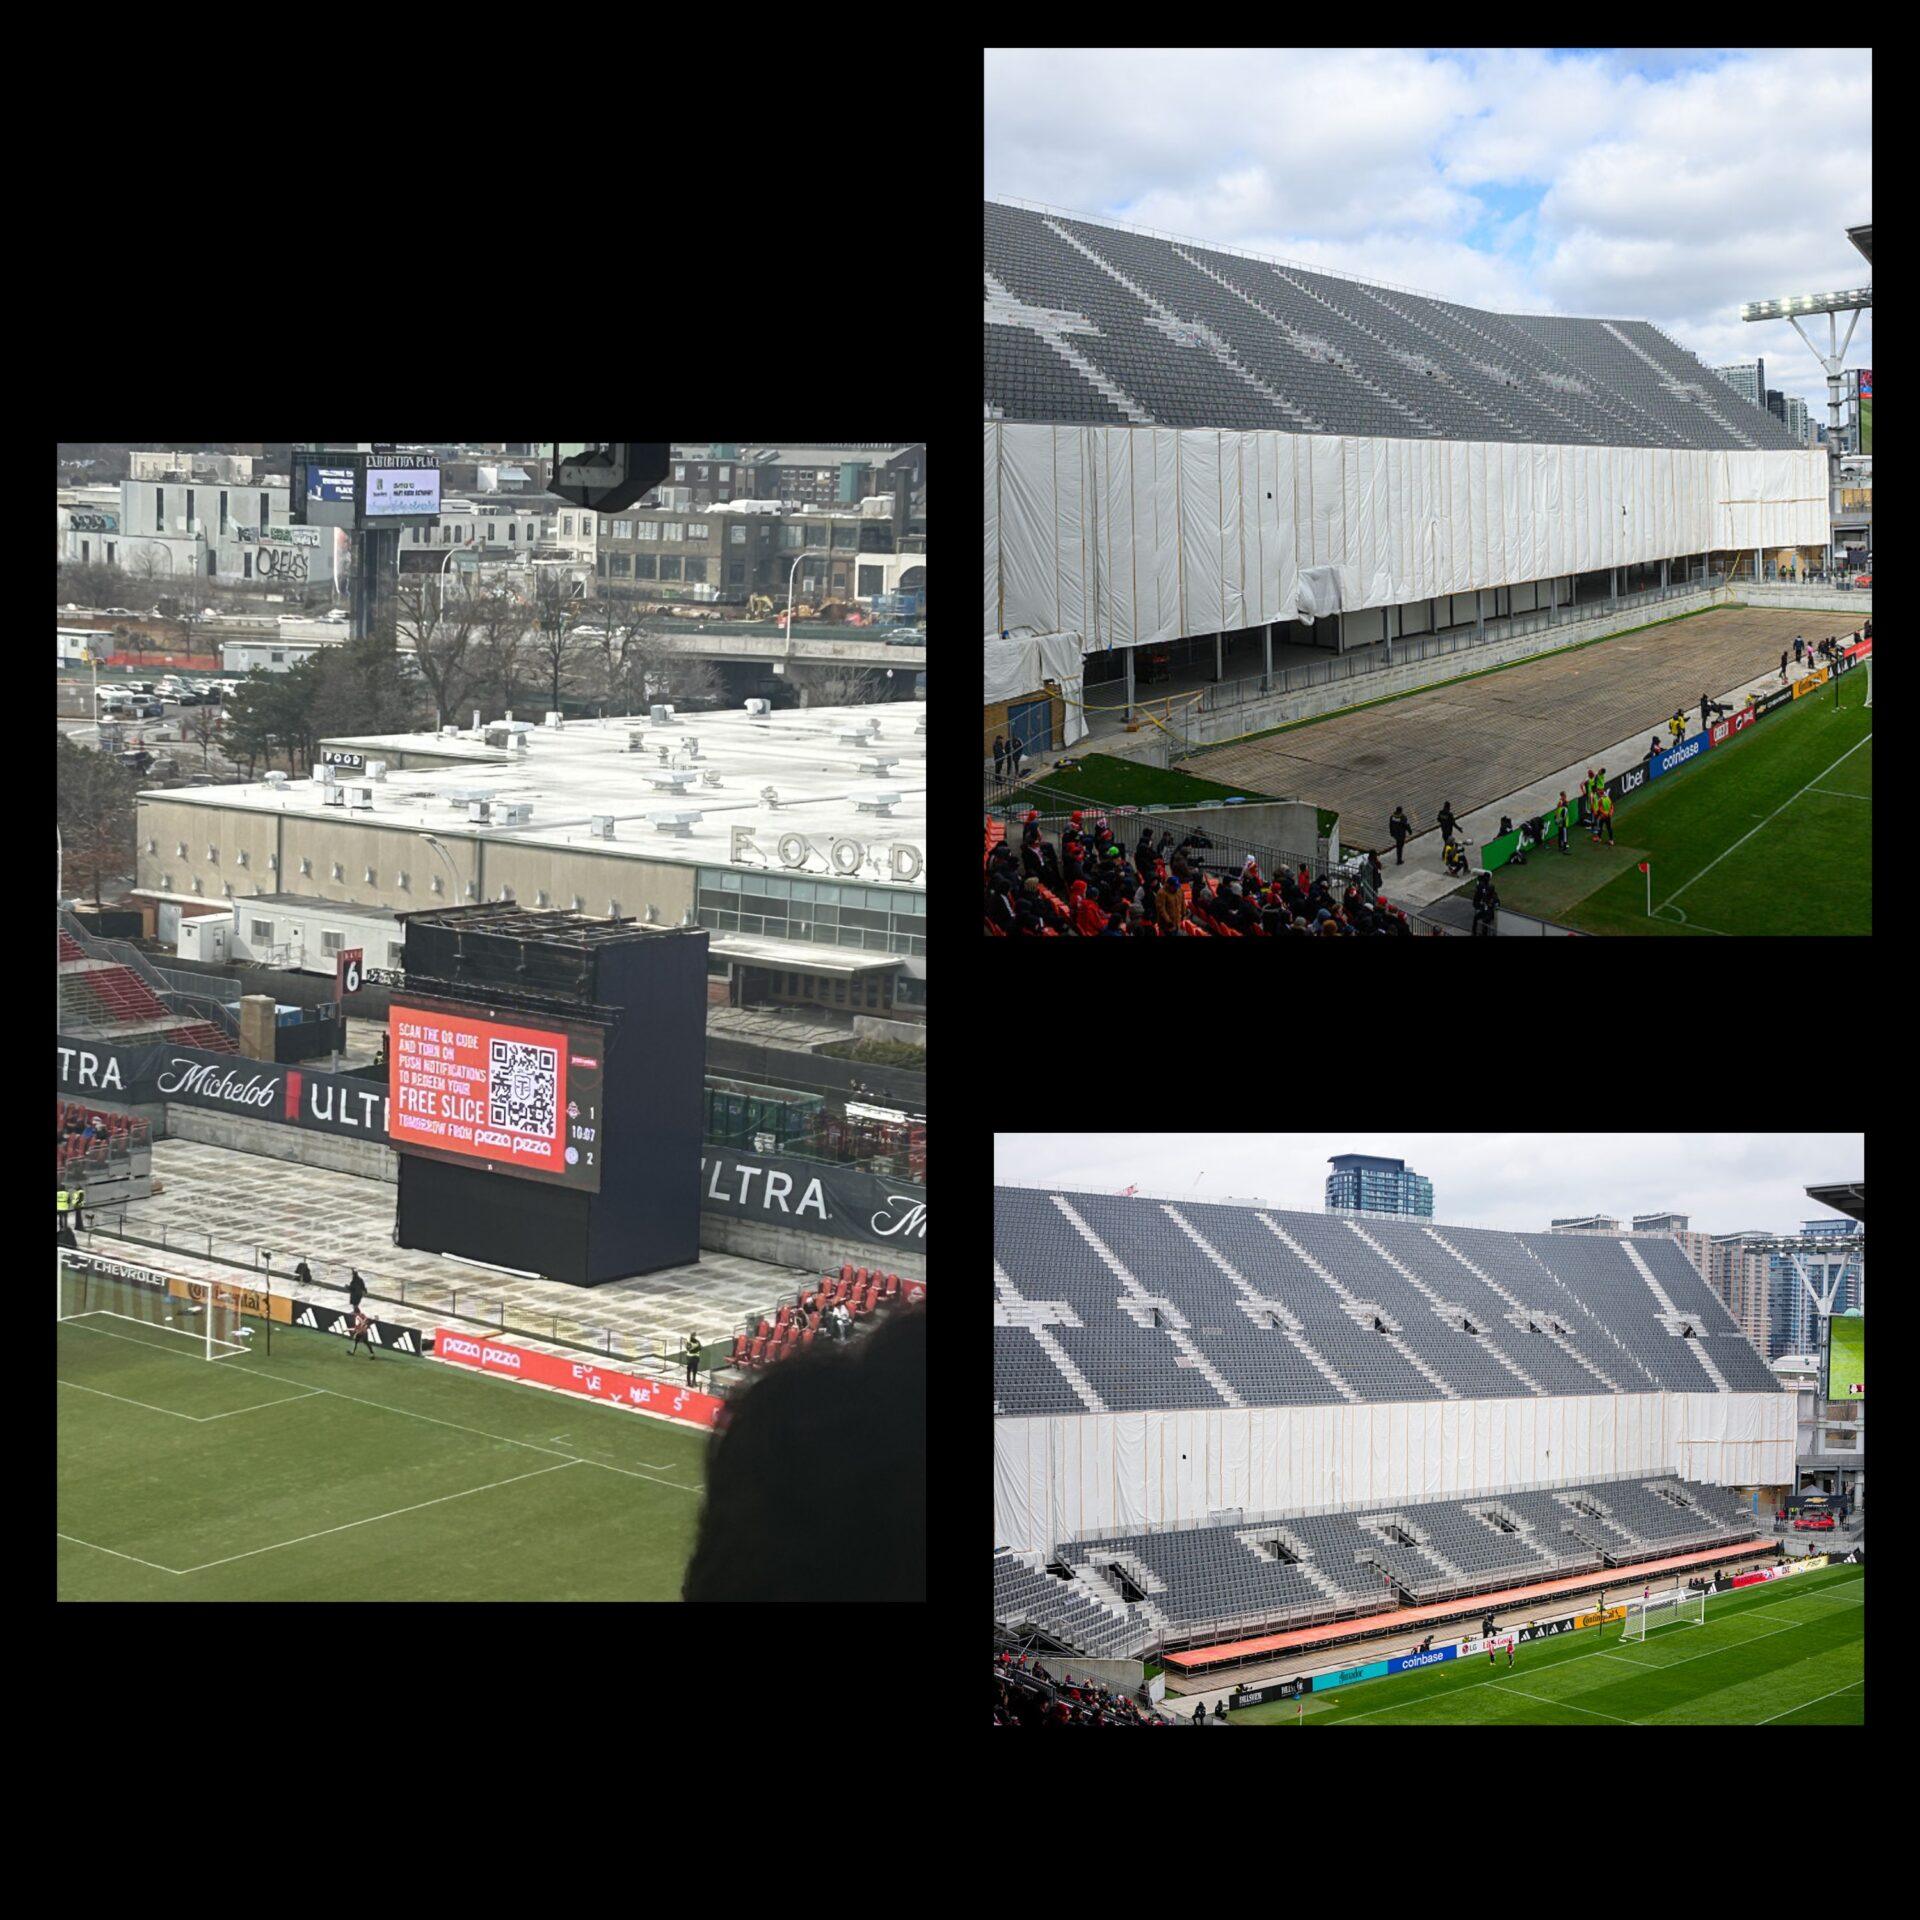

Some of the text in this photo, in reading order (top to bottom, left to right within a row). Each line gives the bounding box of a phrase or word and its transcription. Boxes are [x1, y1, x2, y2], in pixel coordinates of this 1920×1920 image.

[416, 456, 440, 468] PLACE
[1662, 741, 1699, 771] coinbase
[1621, 769, 1644, 793] Uber
[730, 826, 923, 881] FOOD
[346, 962, 359, 992] 6
[399, 1023, 479, 1050] SCAN THE QR CODE
[399, 1039, 455, 1061] AND TURN ON
[399, 1055, 487, 1083] PUSH NOTIFICATIONS
[157, 1057, 389, 1132] Michelob ULT
[399, 1070, 470, 1096] TO REDEEM YOUR
[399, 1087, 485, 1124] FREE SLICE
[399, 1114, 551, 1156] TOMORROW FROM pizza pizza
[586, 1152, 594, 1165] 2
[702, 1157, 827, 1220] LTRA
[93, 1260, 168, 1286] CHEVROLET
[443, 1338, 521, 1369] pizza pizza
[1402, 1651, 1443, 1669] coinbase
[1469, 1643, 1477, 1652] LG
